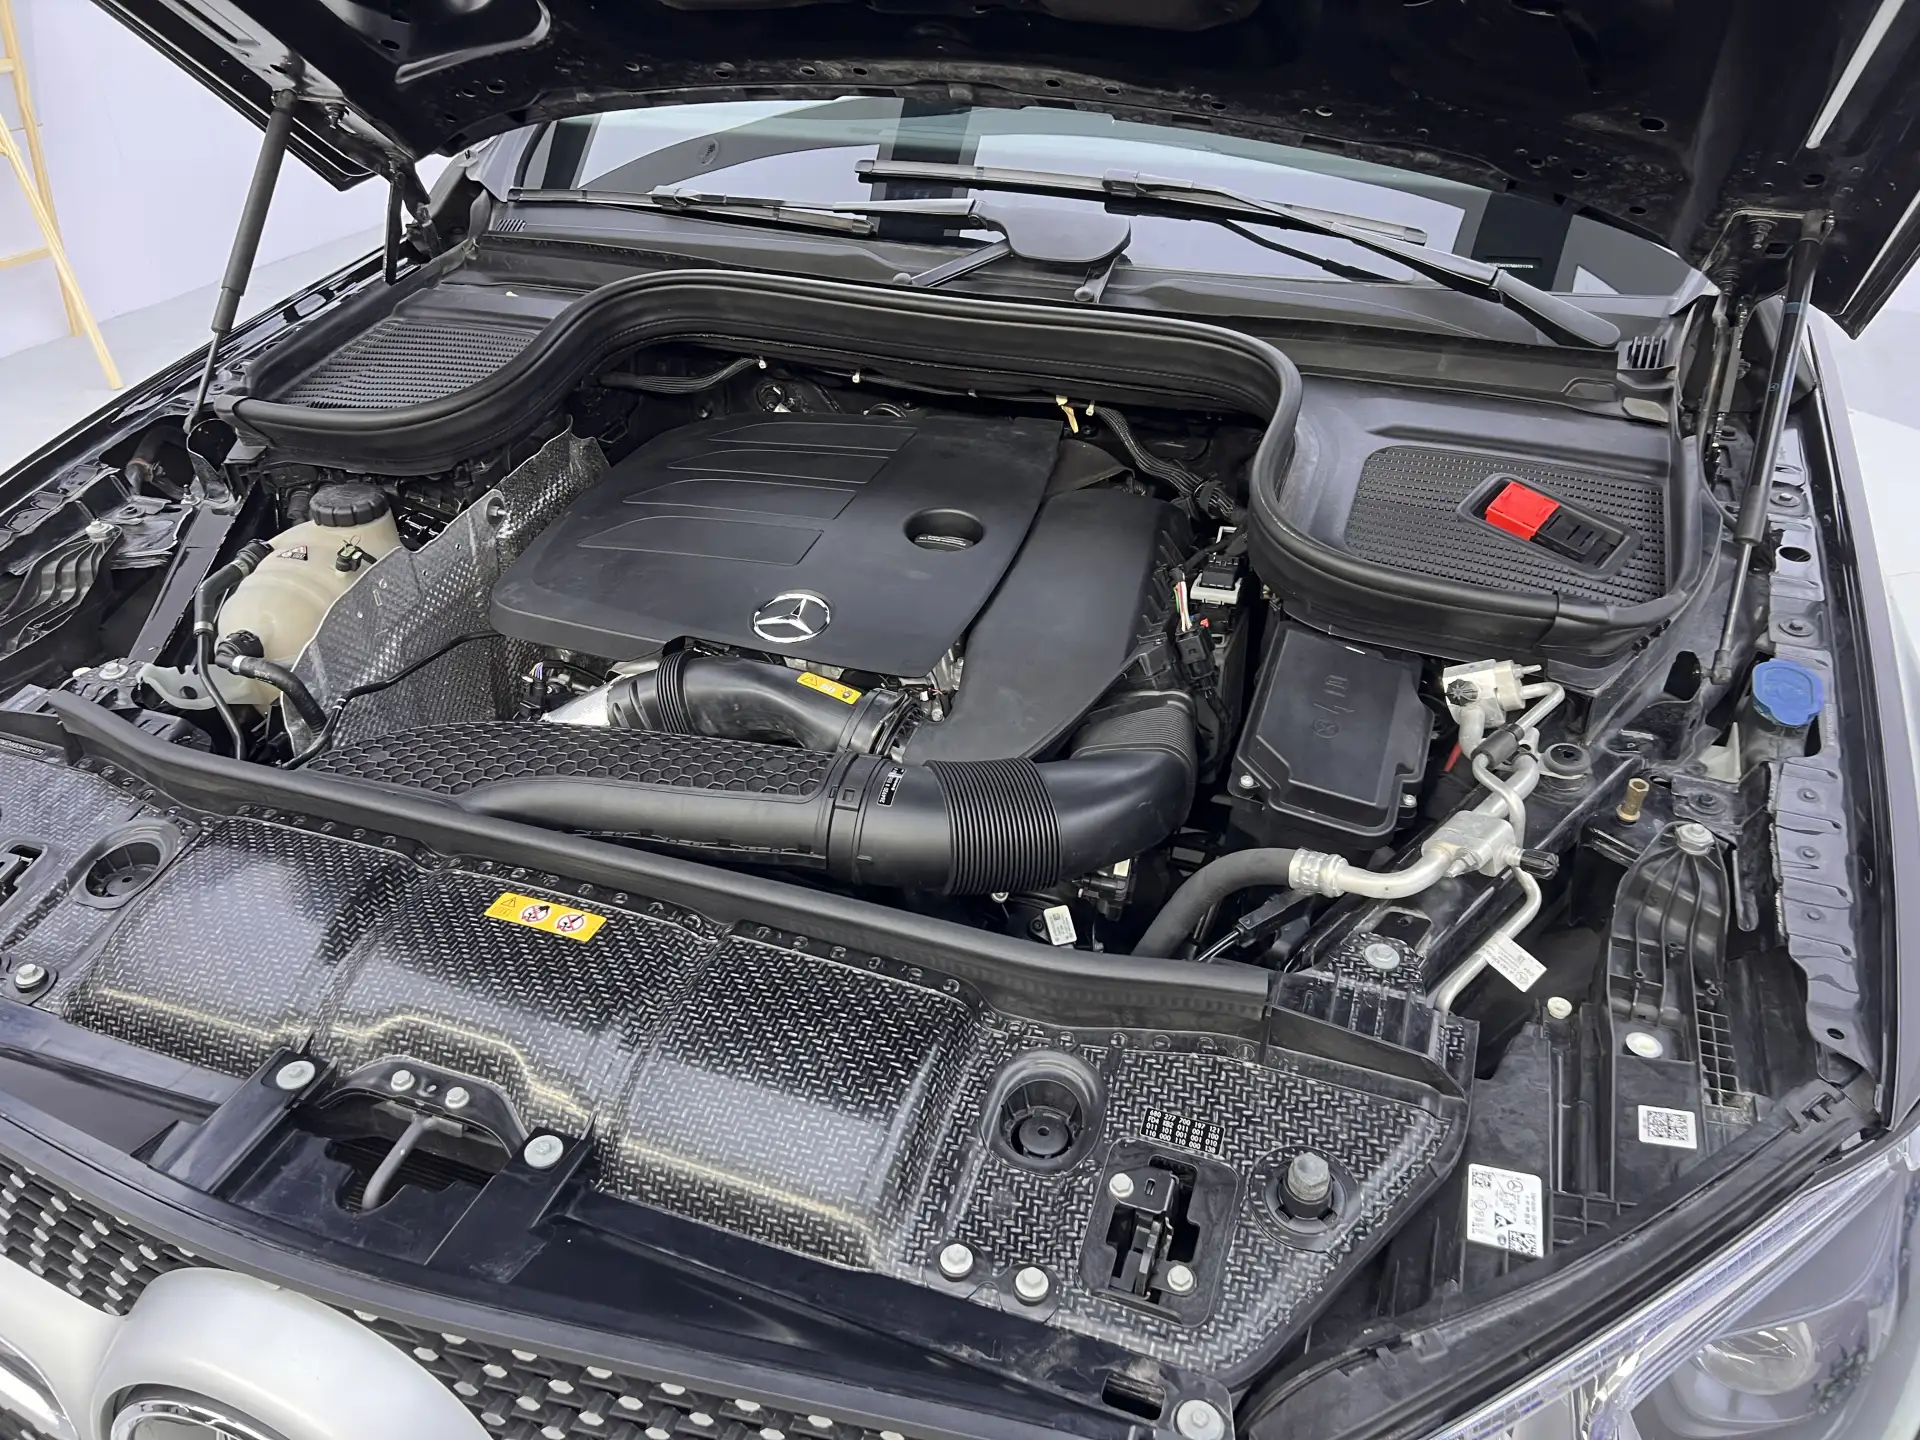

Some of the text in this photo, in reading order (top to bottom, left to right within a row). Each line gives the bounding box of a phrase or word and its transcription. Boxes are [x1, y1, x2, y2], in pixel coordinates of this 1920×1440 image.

[1179, 1117, 1191, 1126] 700
[1146, 1122, 1158, 1130] 011
[1192, 1128, 1204, 1136] 001
[1159, 1133, 1171, 1141] 000
[1175, 1136, 1186, 1145] 110
[1189, 1141, 1201, 1149] 000
